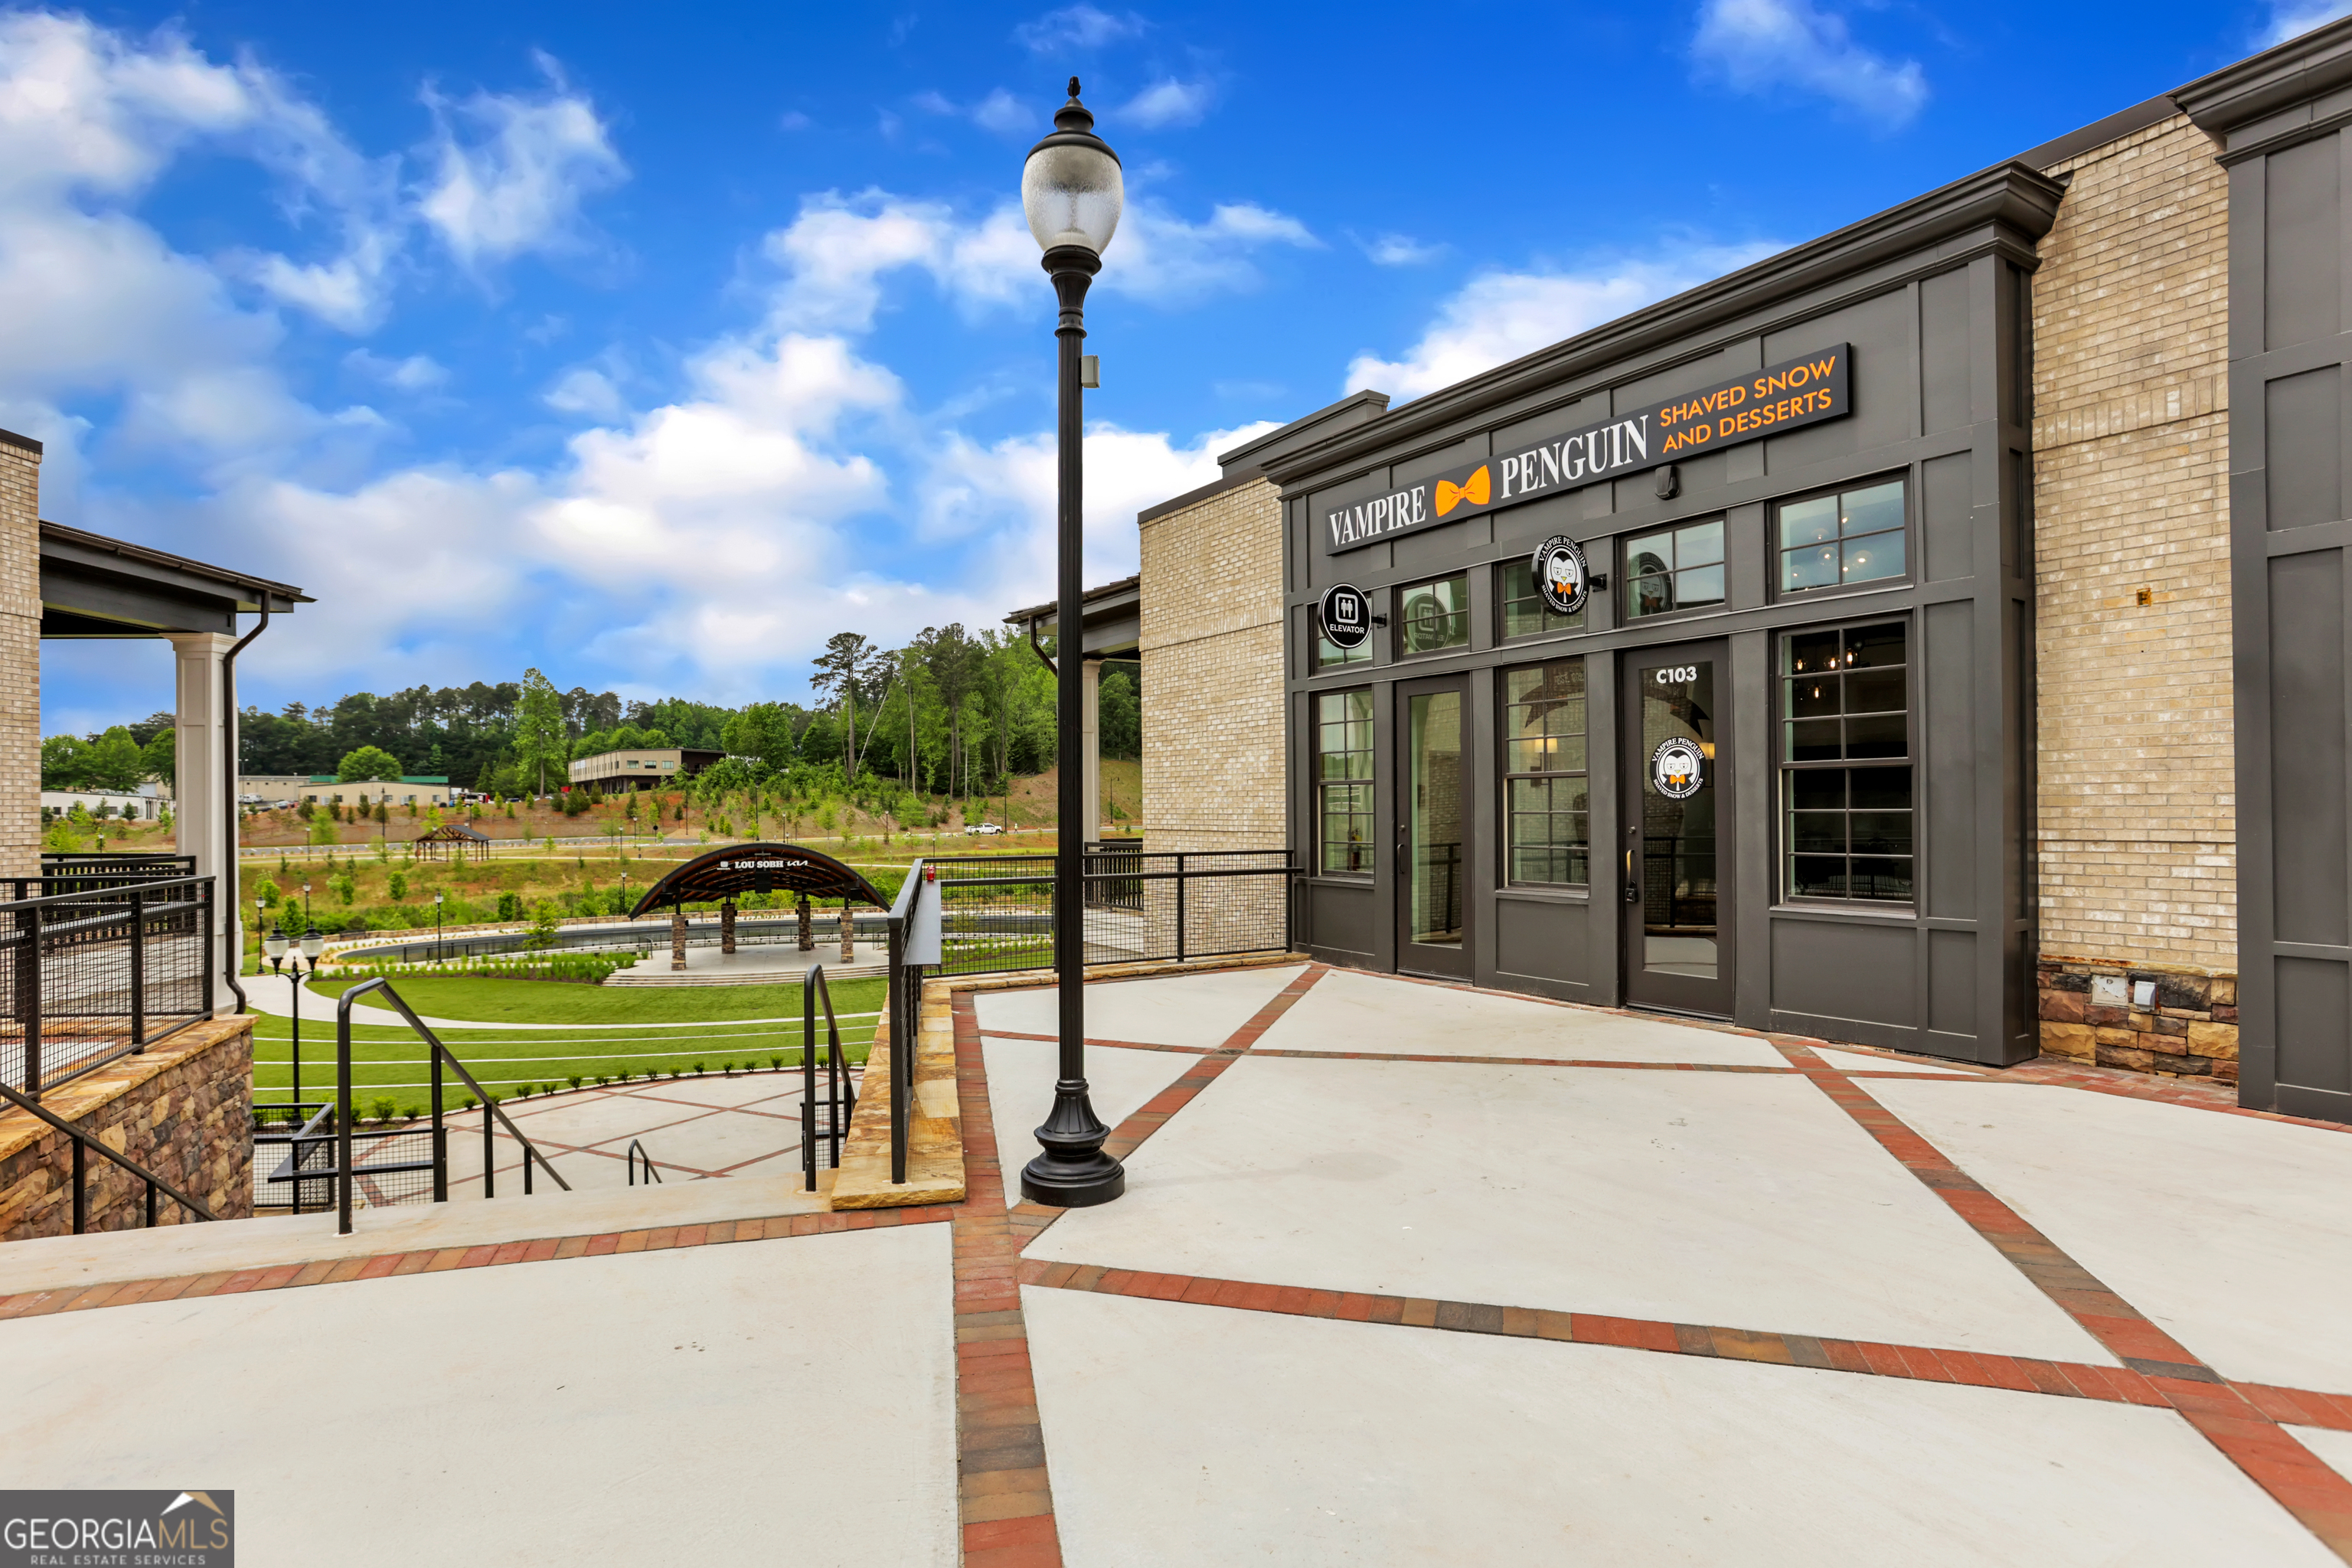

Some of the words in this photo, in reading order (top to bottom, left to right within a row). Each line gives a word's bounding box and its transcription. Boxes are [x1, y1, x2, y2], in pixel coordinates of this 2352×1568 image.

[1659, 386, 1746, 427] SHAVED
[1753, 355, 1835, 399] SNOW
[1662, 426, 1712, 453] AND
[1720, 388, 1831, 438] DESSERTS
[1329, 486, 1426, 546] VAMPIRE
[1501, 415, 1648, 498] PENGUIN
[1539, 536, 1562, 561] VAMPIRE
[1563, 537, 1587, 567] PENGUIN
[1541, 584, 1555, 606] SHAVED
[1572, 590, 1587, 611] DESSERTS
[1330, 623, 1364, 634] ELEVATOR
[1656, 666, 1697, 684] C103
[1651, 737, 1677, 761] VAMPIRE
[1677, 737, 1704, 760] PENGUIN
[1654, 779, 1668, 795] SHAVED
[1685, 777, 1704, 797] DESSERTS
